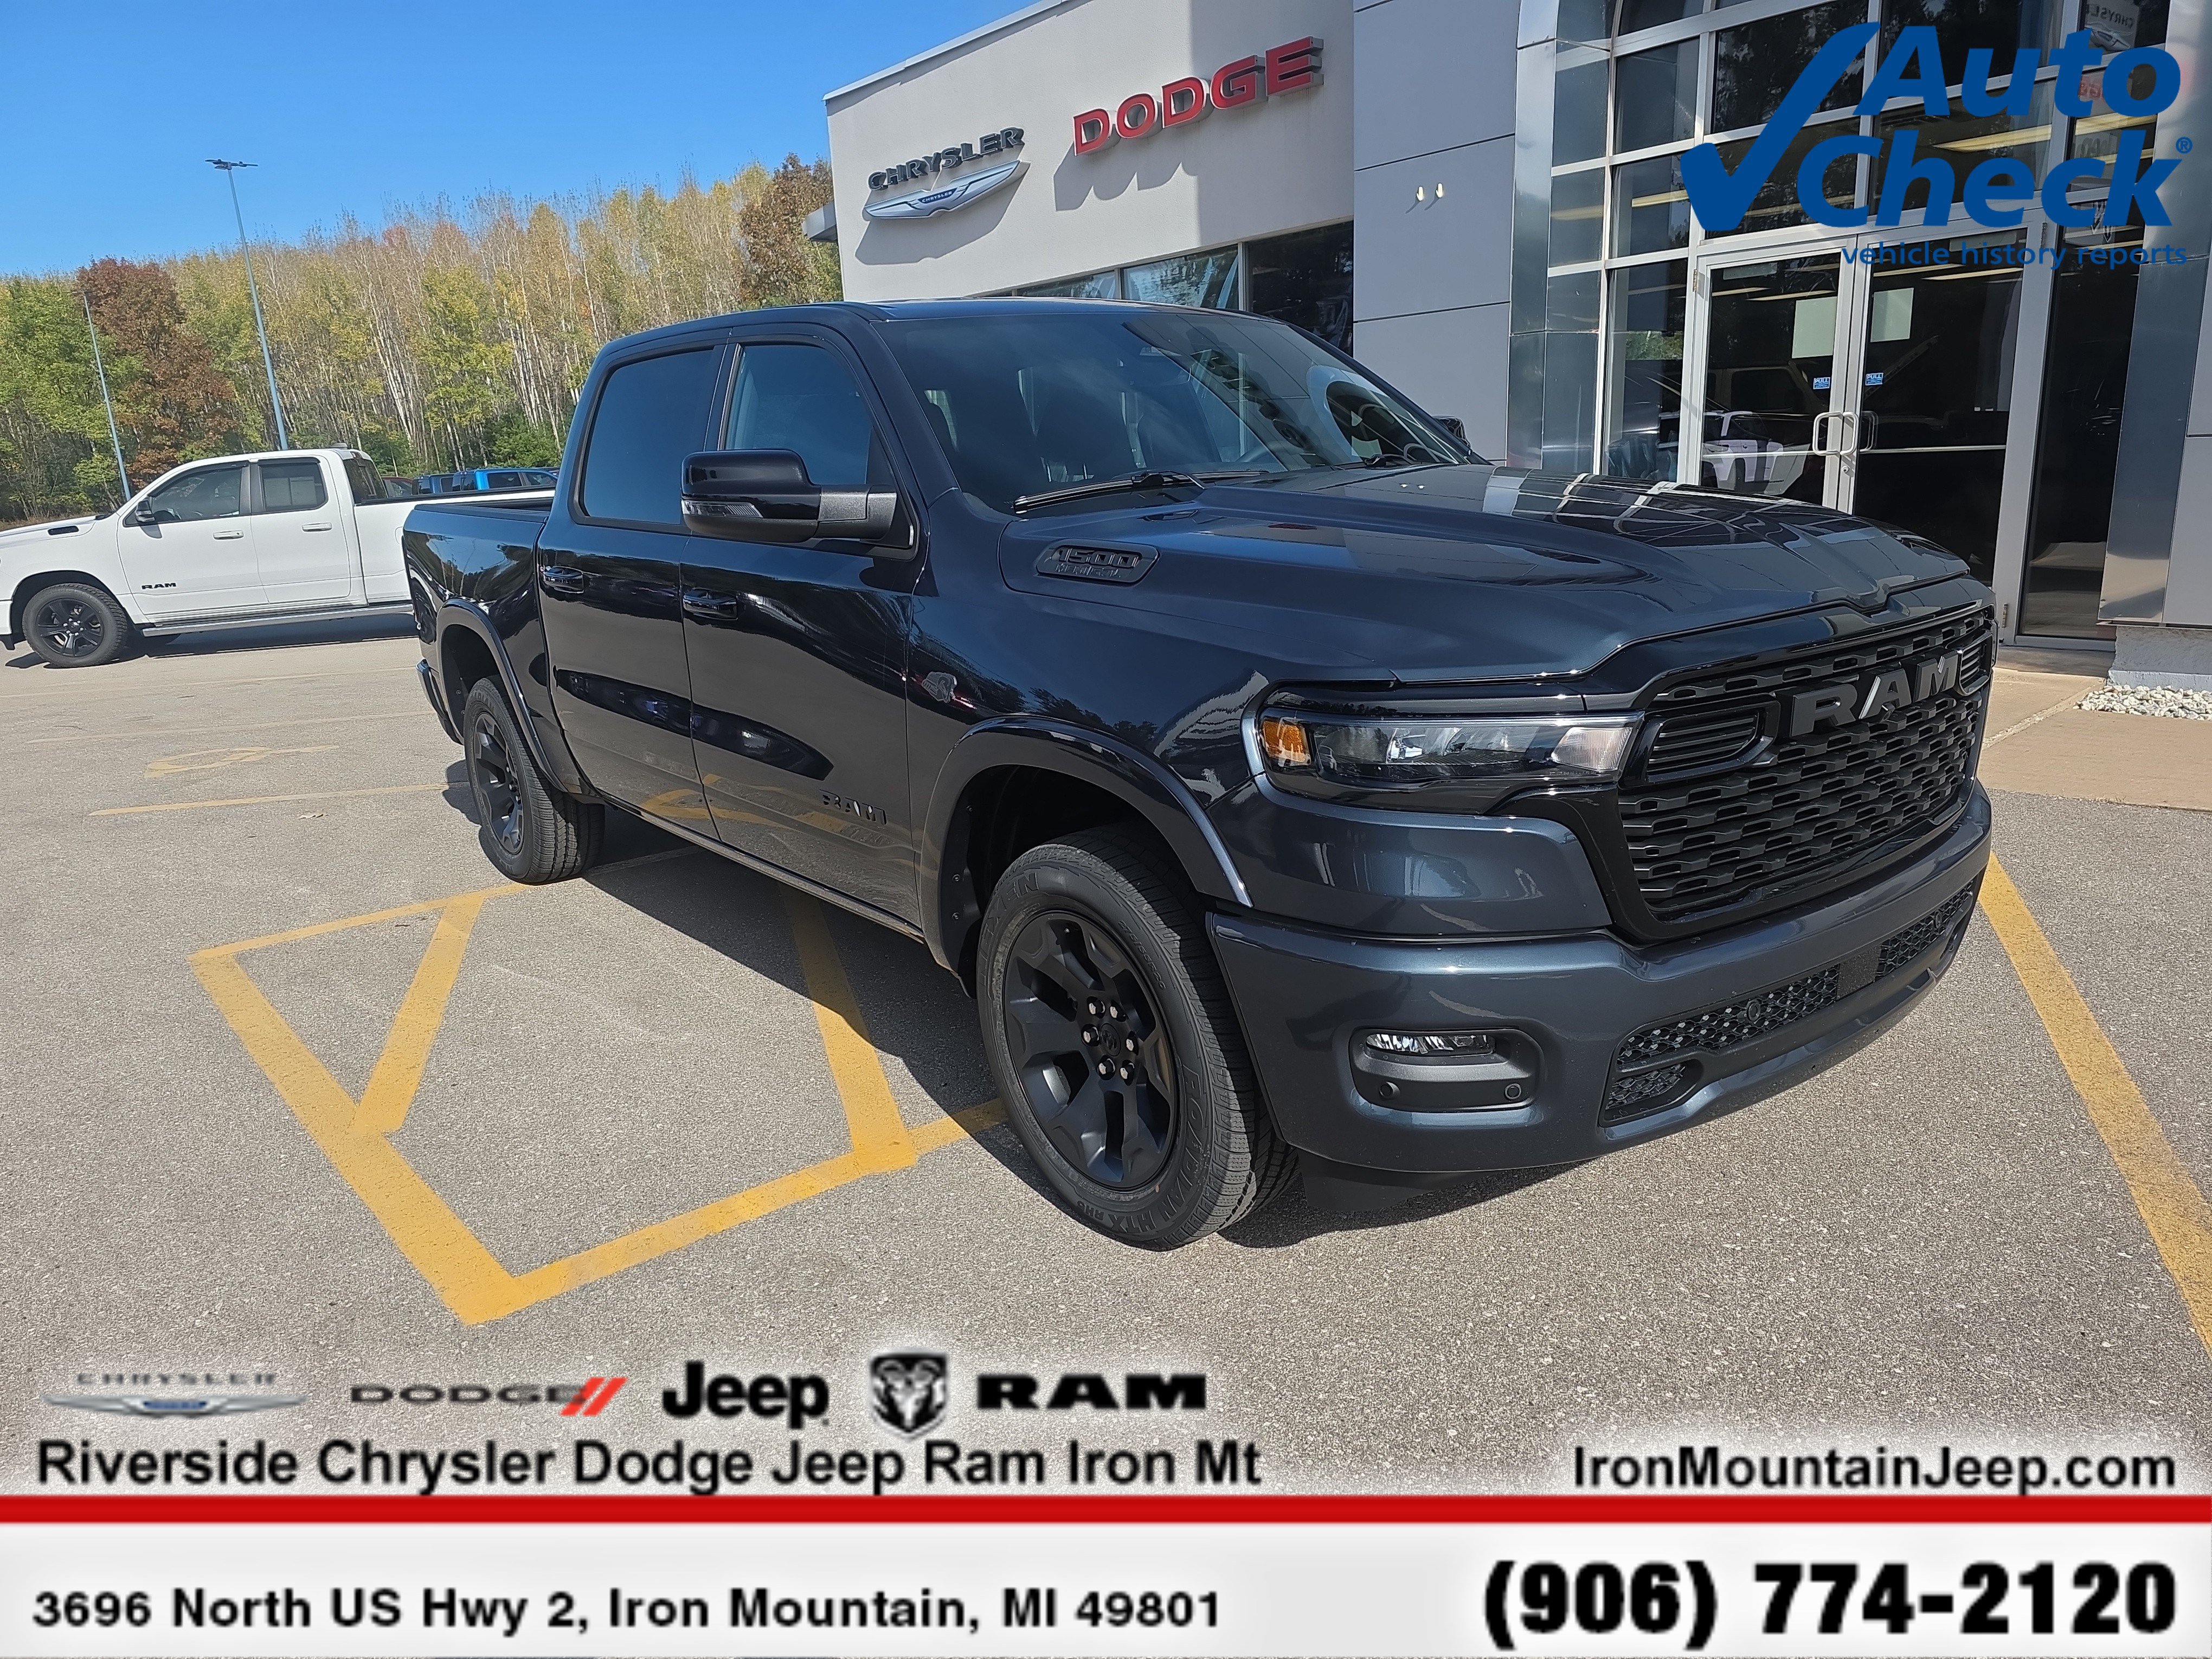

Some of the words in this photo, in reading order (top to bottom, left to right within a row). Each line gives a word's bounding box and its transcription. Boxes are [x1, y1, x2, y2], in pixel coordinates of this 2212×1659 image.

[1073, 36, 1323, 156] DODGE
[868, 126, 1024, 191] CHRYSLER
[922, 191, 953, 203] CHRYSLER
[1058, 548, 1139, 568] 1500
[1790, 650, 1958, 737] RAM
[819, 789, 888, 826] RAM
[1108, 1209, 1158, 1233] HTX
